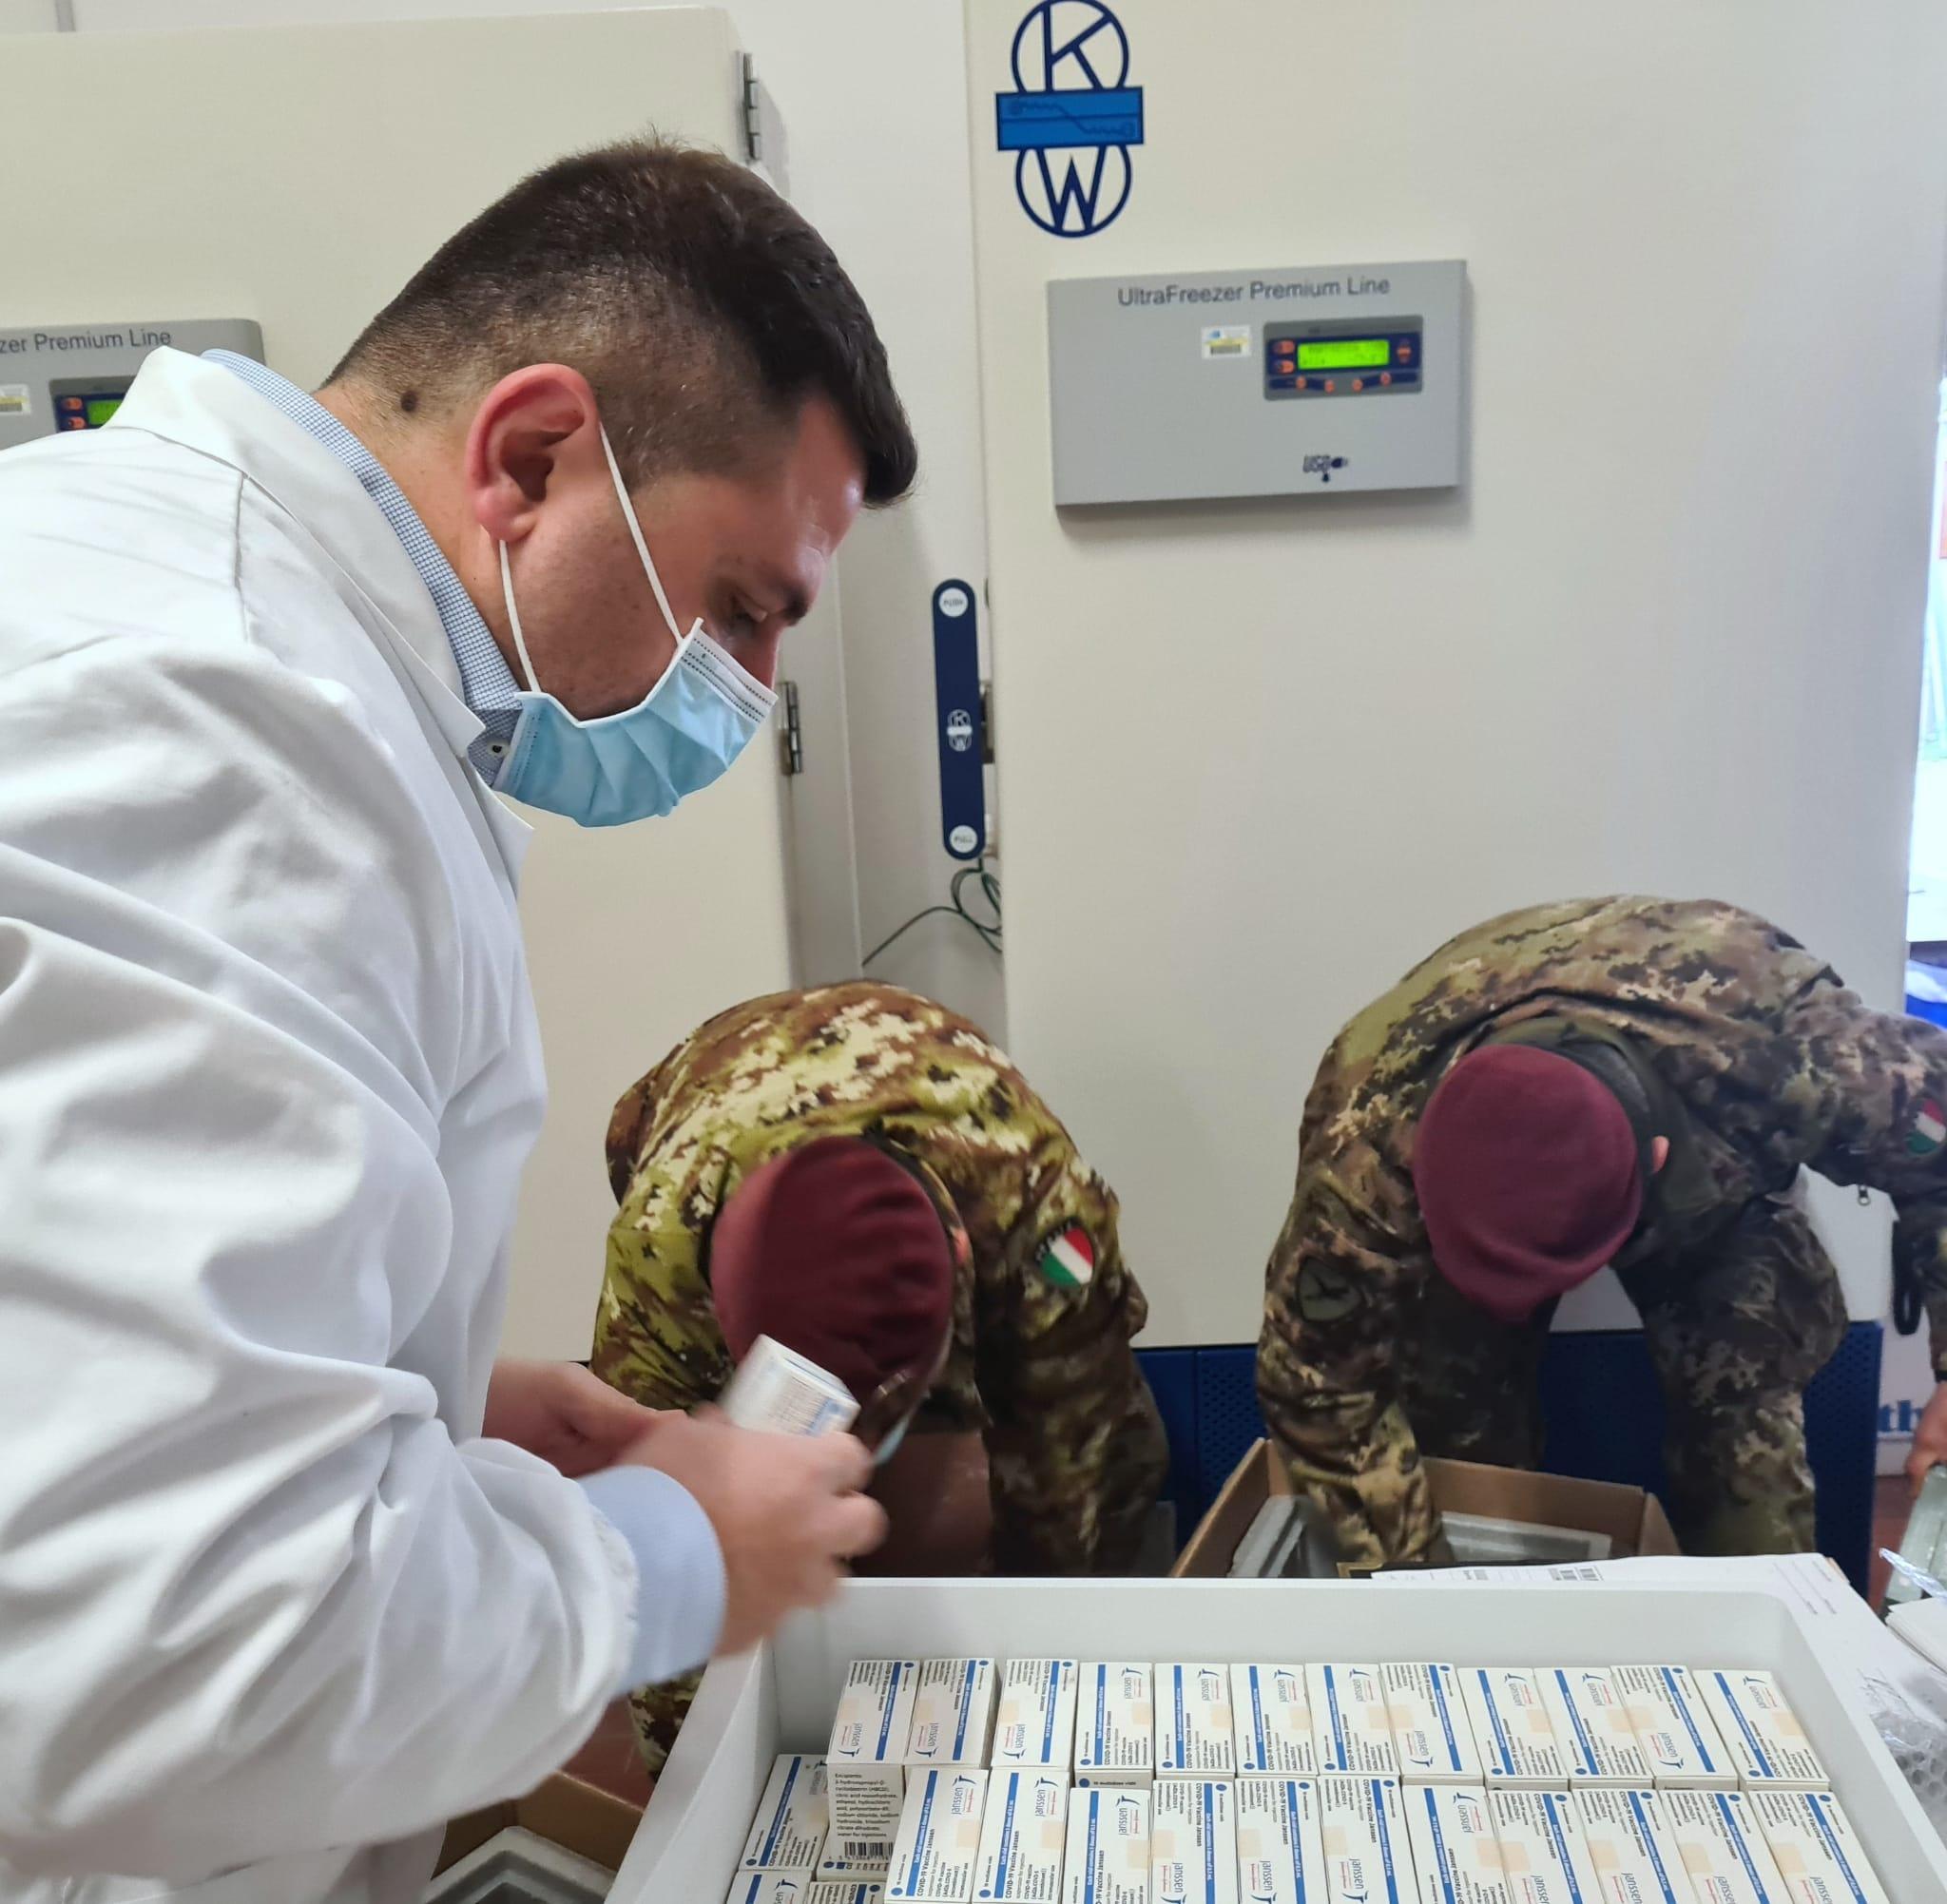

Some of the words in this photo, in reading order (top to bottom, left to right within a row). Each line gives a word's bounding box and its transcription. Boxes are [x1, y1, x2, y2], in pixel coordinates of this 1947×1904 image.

[1118, 284, 1243, 306] UltraFreezer
[1250, 279, 1340, 299] Premium
[1347, 276, 1391, 296] Line
[35, 331, 124, 351] Premium
[129, 329, 171, 346] Line
[950, 1787, 965, 1814] janssen
[1033, 1789, 1047, 1816] janssen
[1363, 1779, 1372, 1801] COVID-19
[1369, 1823, 1378, 1842] Janssen
[1118, 1809, 1129, 1836] janssen
[1457, 1805, 1474, 1833] janssen
[927, 1830, 935, 1849] Janssen
[923, 1851, 932, 1870] Vaccine
[1448, 1849, 1456, 1869] Janssen
[916, 1872, 927, 1896] COVID-19
[1005, 1874, 1014, 1899] COVID-19
[1173, 1863, 1184, 1893] janssen
[1261, 1860, 1274, 1891] janssen
[1350, 1859, 1365, 1889] janssen
[1453, 1871, 1461, 1891] Vaccine
[1715, 1876, 1735, 1904] jansse
[1810, 1877, 1832, 1904] jansse
